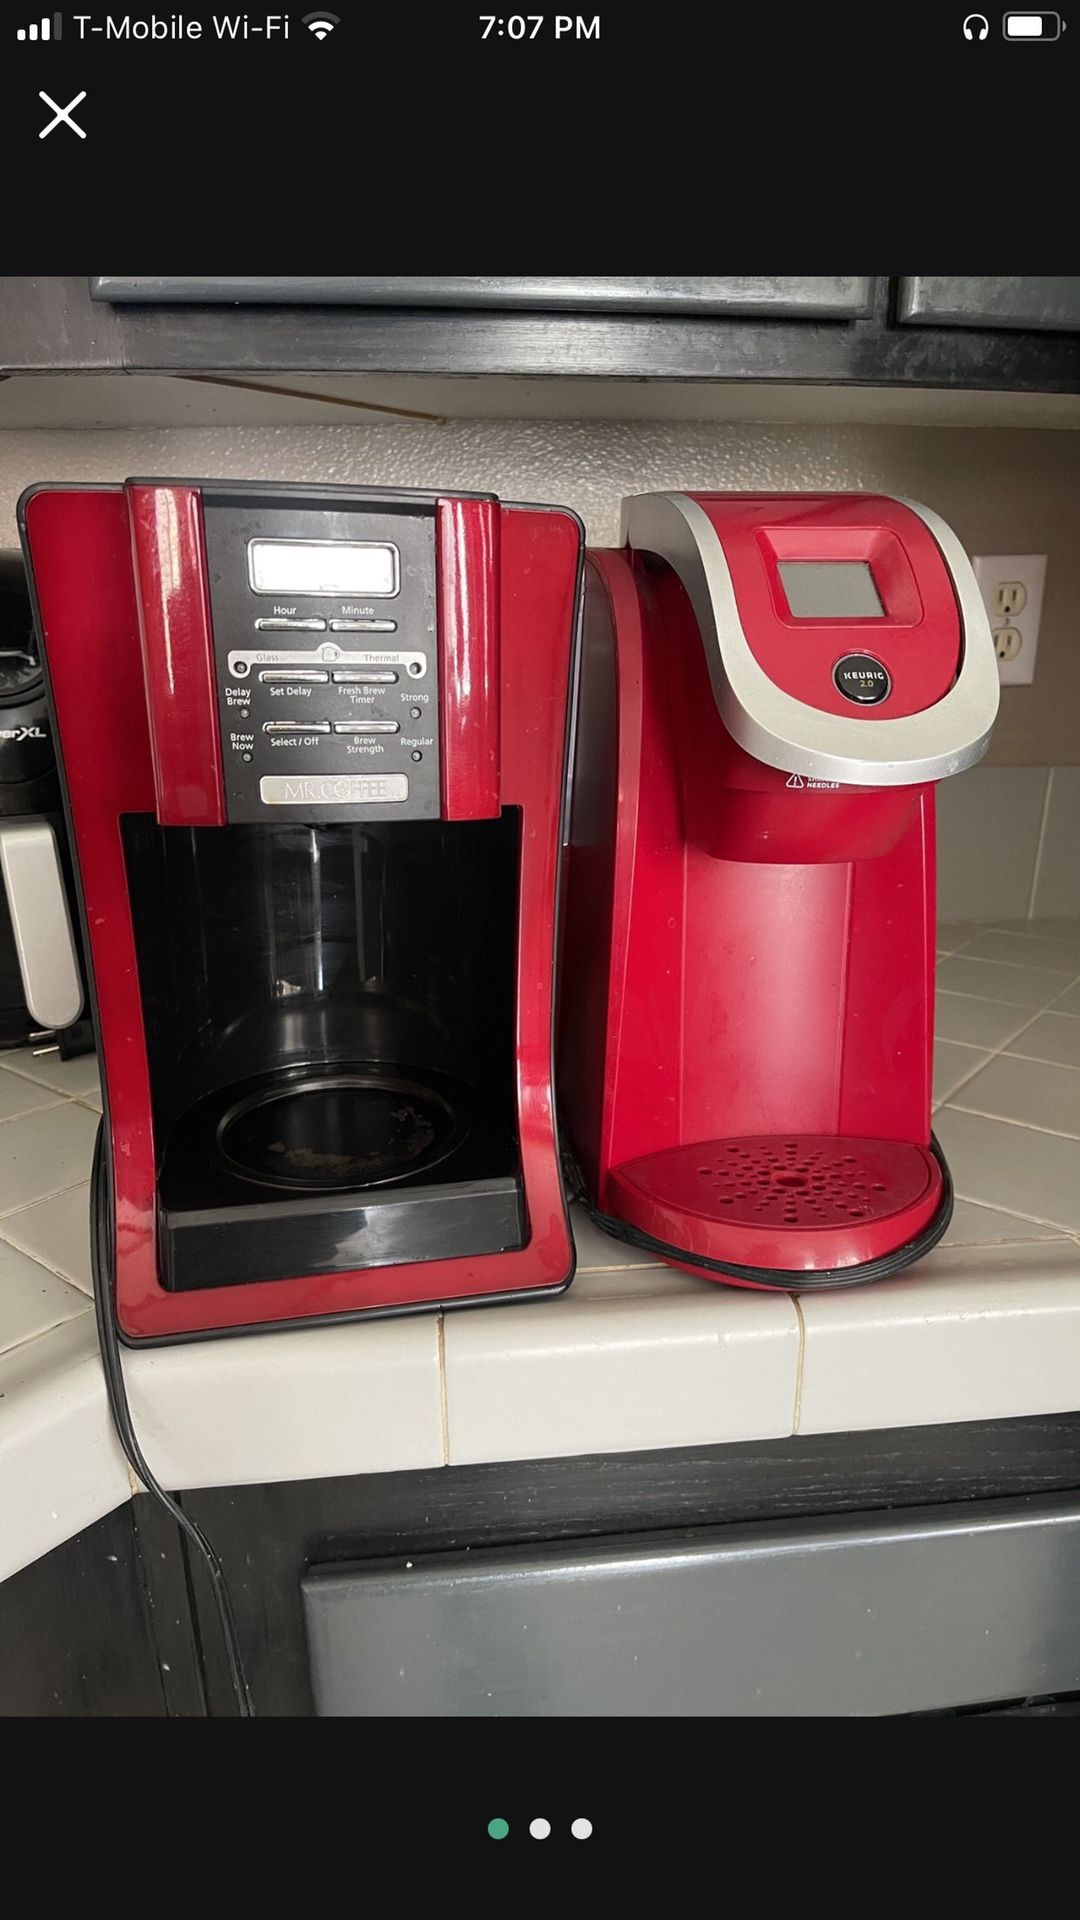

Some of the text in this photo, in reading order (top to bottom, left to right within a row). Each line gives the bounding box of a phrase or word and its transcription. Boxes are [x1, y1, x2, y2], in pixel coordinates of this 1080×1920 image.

[273, 605, 297, 615] Hour
[342, 605, 375, 615] Minute
[256, 653, 279, 662] Glass
[364, 653, 399, 662] Thermal
[843, 671, 885, 680] KEURIG
[860, 680, 874, 688] 2.0
[225, 688, 251, 699] Delay
[270, 686, 312, 697] Set Delay
[338, 686, 386, 695] Fresh Brew
[227, 697, 251, 706] Brew
[350, 695, 375, 704] Timer
[401, 692, 429, 703] Strong
[230, 733, 254, 741] Brew
[271, 738, 296, 746] Select
[304, 736, 319, 746] Off
[354, 736, 376, 744] Brew
[232, 742, 254, 750] Now
[401, 737, 433, 747] Regular
[347, 744, 384, 754] Strength
